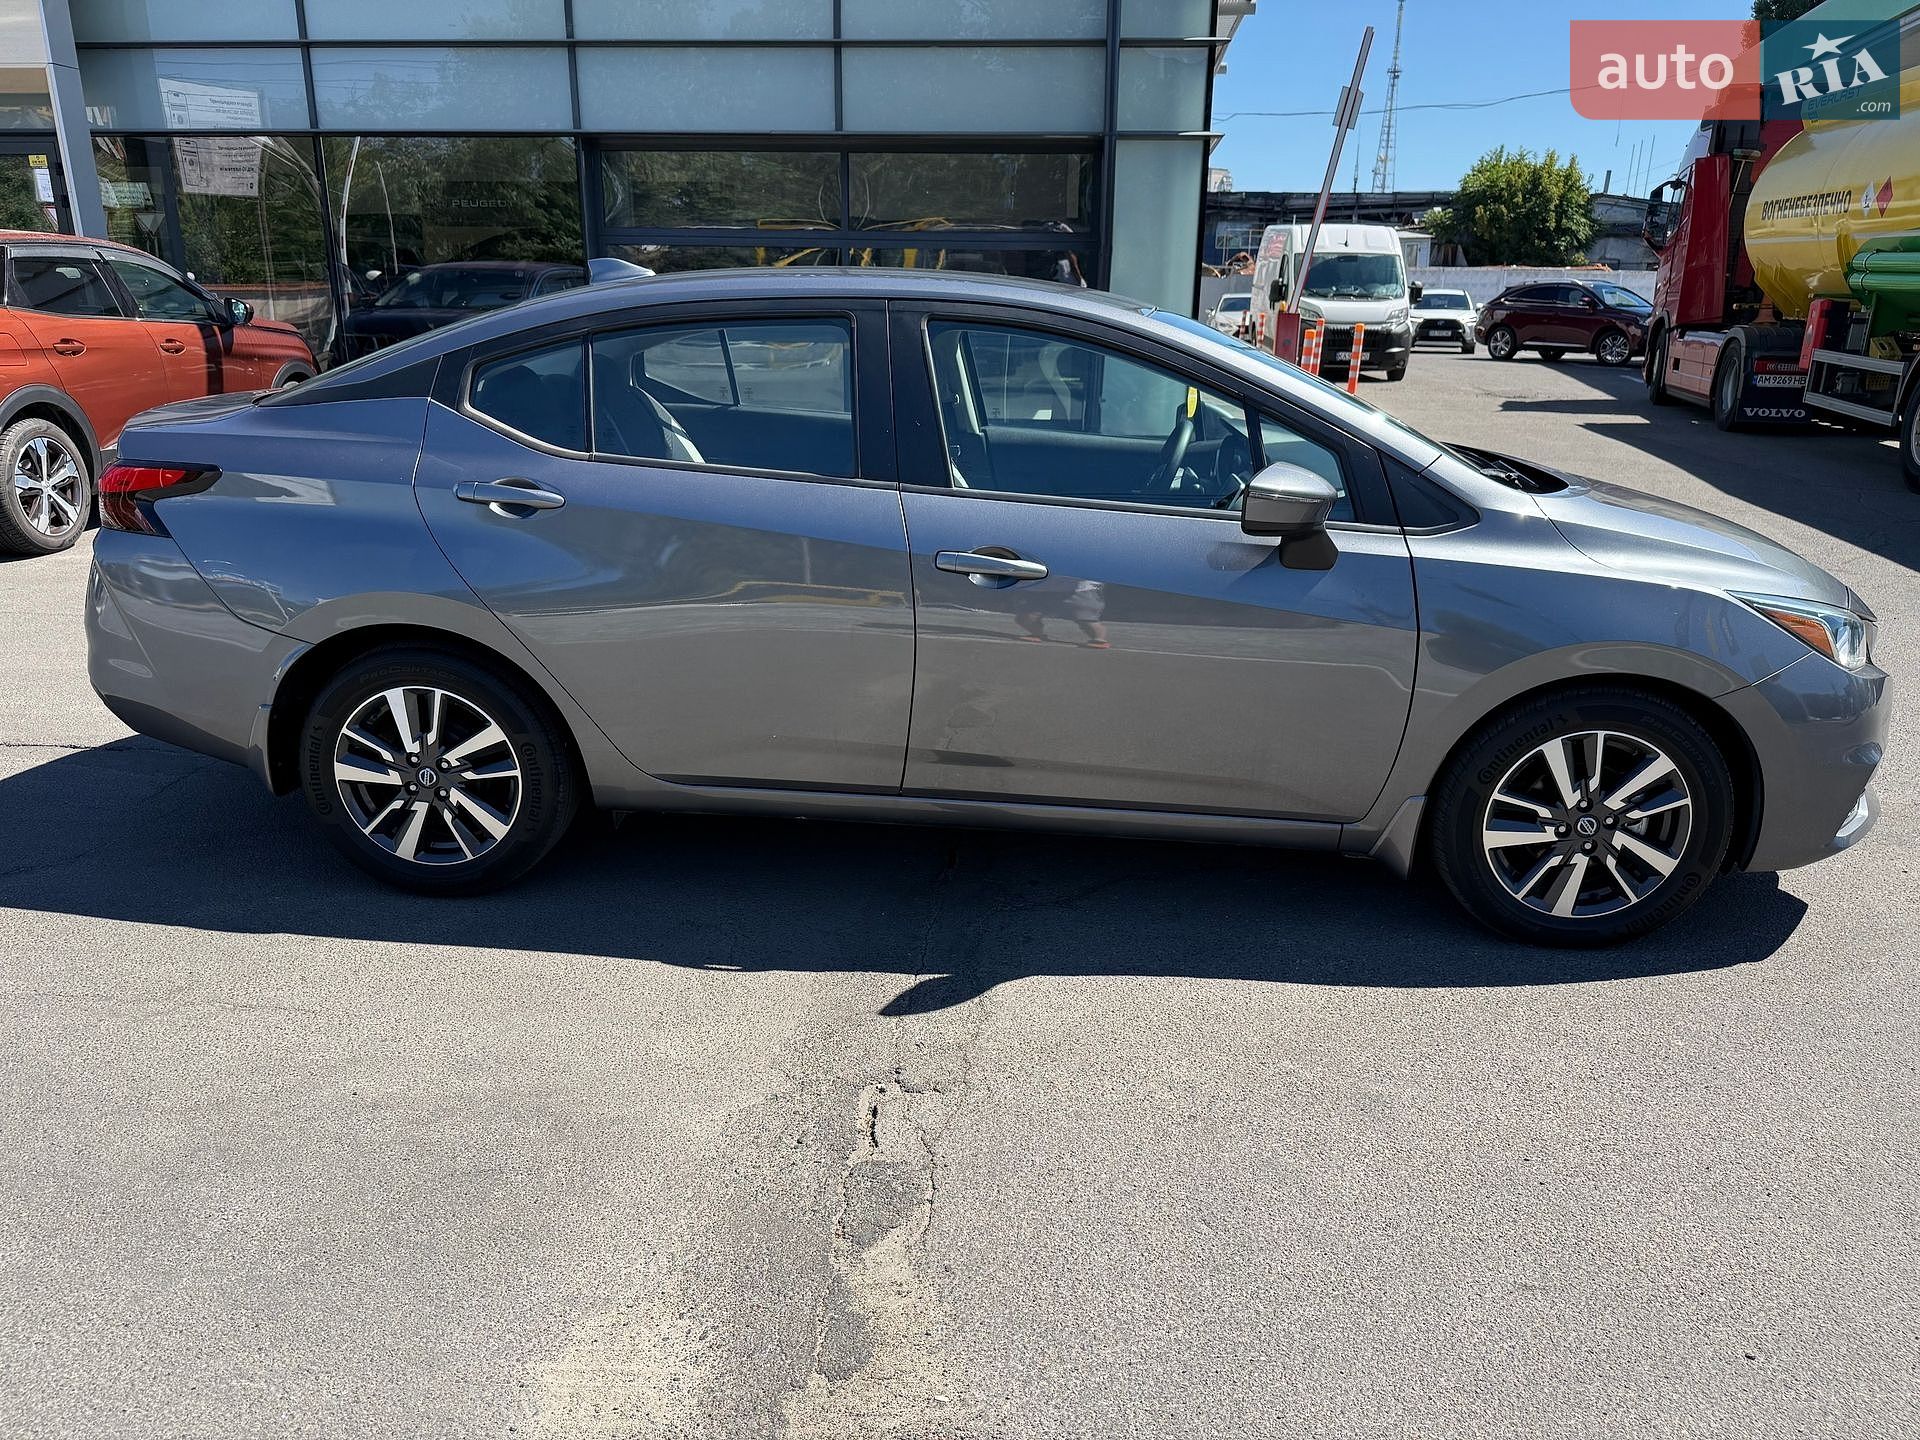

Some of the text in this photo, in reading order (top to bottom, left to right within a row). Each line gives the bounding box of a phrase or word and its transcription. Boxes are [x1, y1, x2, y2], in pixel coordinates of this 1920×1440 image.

[452, 199, 512, 208] PEUGEO
[1761, 190, 1852, 221] ВОГНЕНЕБЕЗПЕЧНО
[1772, 375, 1793, 386] 9269
[1743, 407, 1806, 418] VOLVO
[1477, 717, 1554, 785] Continental
